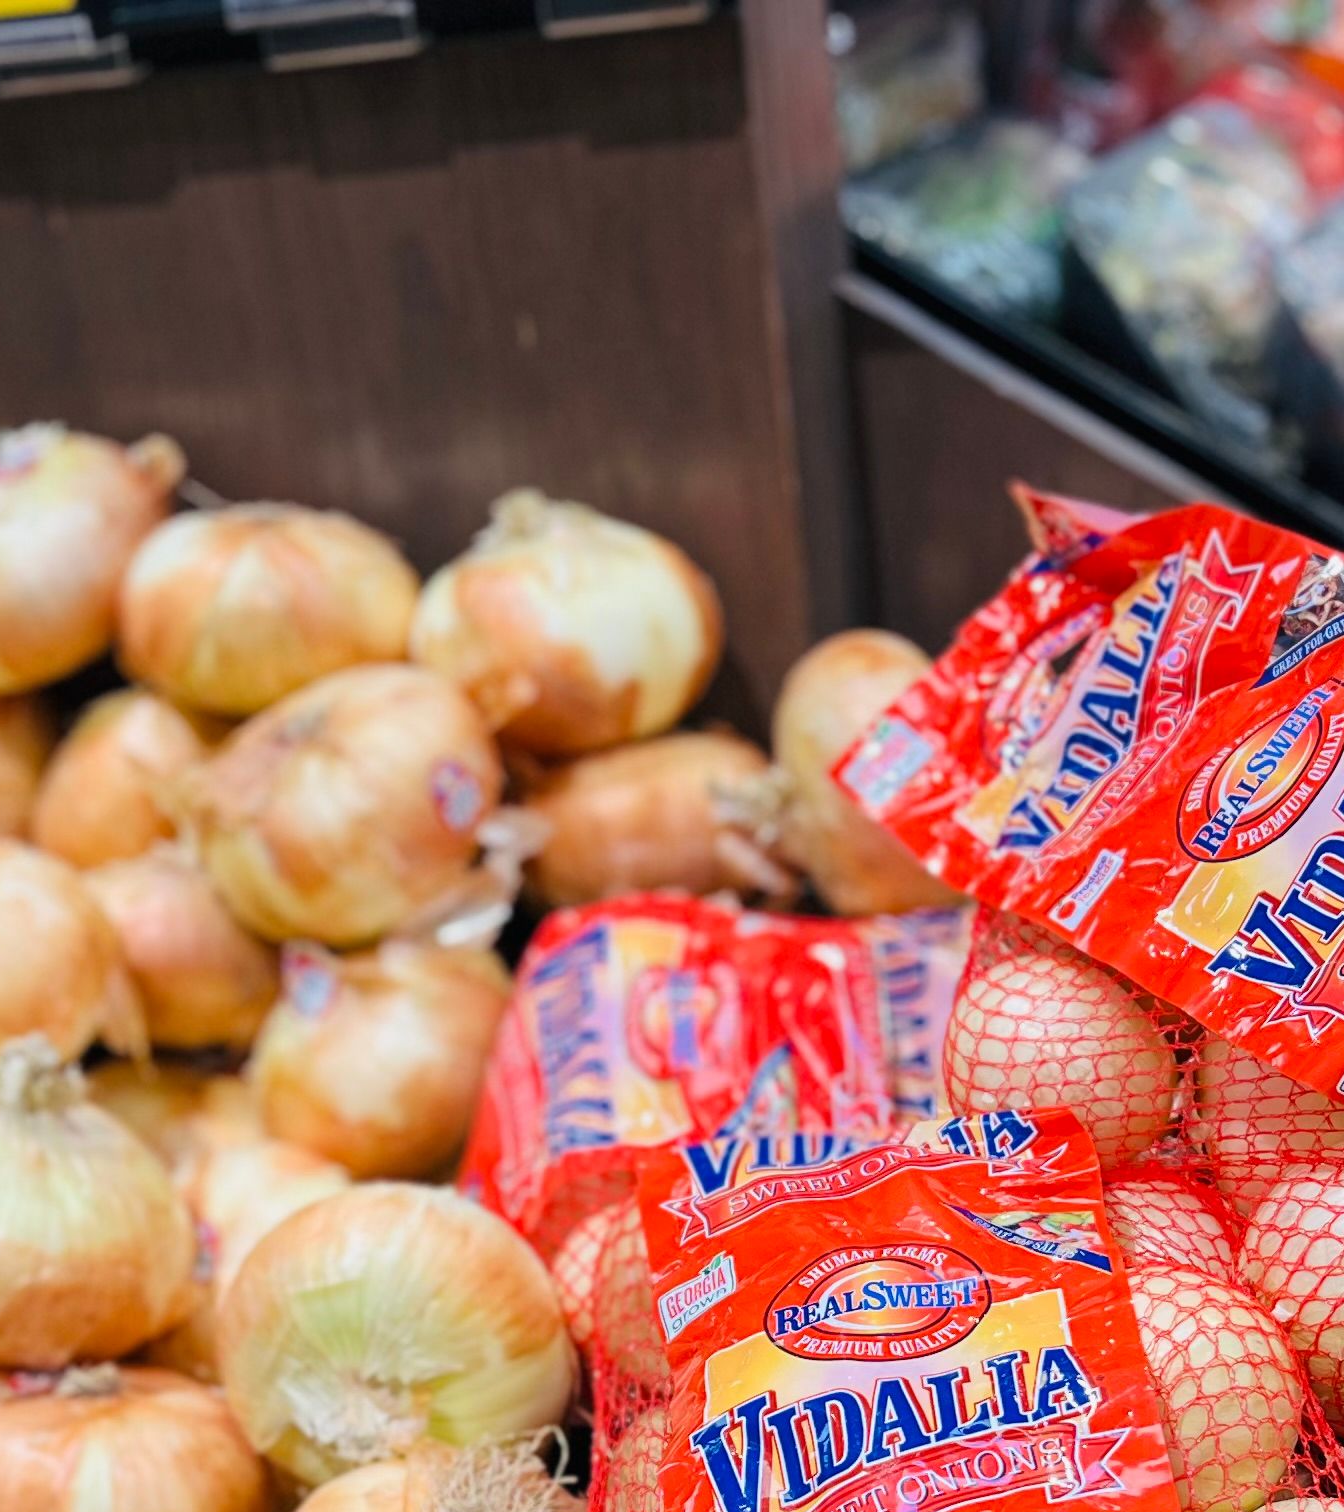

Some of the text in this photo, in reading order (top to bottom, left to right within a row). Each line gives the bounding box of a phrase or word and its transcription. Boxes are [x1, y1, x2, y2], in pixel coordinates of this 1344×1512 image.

[1271, 650, 1303, 679] GREAT
[1304, 633, 1325, 655] FOR
[1073, 591, 1210, 840] SWEET ONIONS
[1184, 744, 1233, 812] SHUMAN
[1190, 684, 1336, 858] REALSWEET
[1234, 783, 1313, 851] PREMIUM
[729, 1169, 856, 1214] SWEET
[663, 1270, 729, 1320] GEORGIA
[797, 1245, 950, 1290] SHUMAN FARMS
[669, 1286, 729, 1334] grown
[773, 1274, 979, 1338] REALSWEET
[792, 1319, 964, 1359] PREMIUM QUALITY
[896, 1436, 1066, 1505] ONIONS
